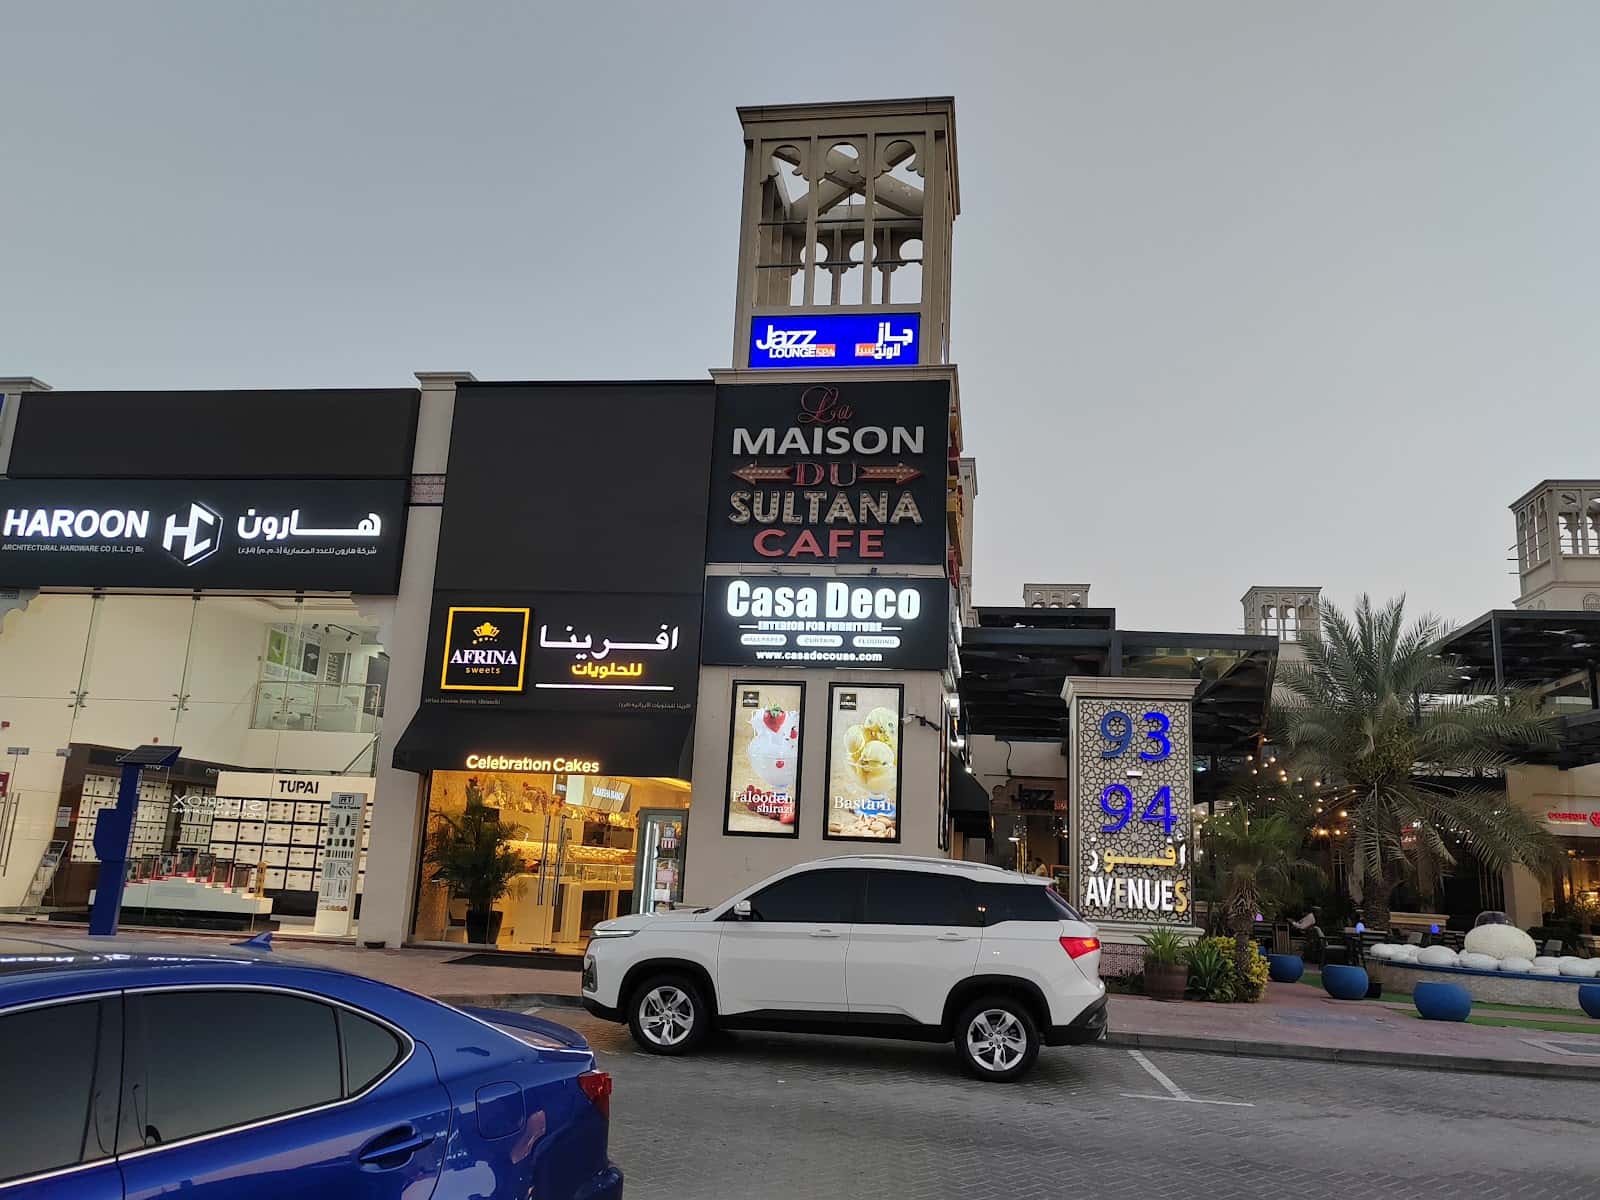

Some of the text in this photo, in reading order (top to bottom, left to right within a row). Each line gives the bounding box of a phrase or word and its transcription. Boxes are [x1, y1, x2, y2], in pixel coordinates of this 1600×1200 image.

[756, 325, 817, 349] Jazz
[876, 322, 914, 347] جاز
[769, 347, 816, 358] LOUNGE
[798, 386, 853, 423] La
[732, 426, 924, 455] MAISON
[793, 462, 857, 487] DU
[728, 490, 923, 524] SULTANA
[3, 509, 149, 538] HAROON
[237, 508, 382, 541] هارون
[2, 544, 58, 552] ARCHITECTURAL
[357, 546, 377, 555] شركة
[753, 529, 885, 558] CAFE
[727, 580, 921, 620] Casa Deco
[450, 649, 518, 665] AFRINA
[465, 665, 501, 674] sweets
[571, 661, 643, 679] للحلويات
[1100, 710, 1172, 761] 93
[466, 754, 600, 773] Celebration Cakes
[279, 780, 319, 794] TUPAI
[756, 803, 793, 814] shirazi
[834, 795, 891, 810] Bastani
[1101, 783, 1177, 834] 94
[1085, 876, 1188, 912] AVENUES
